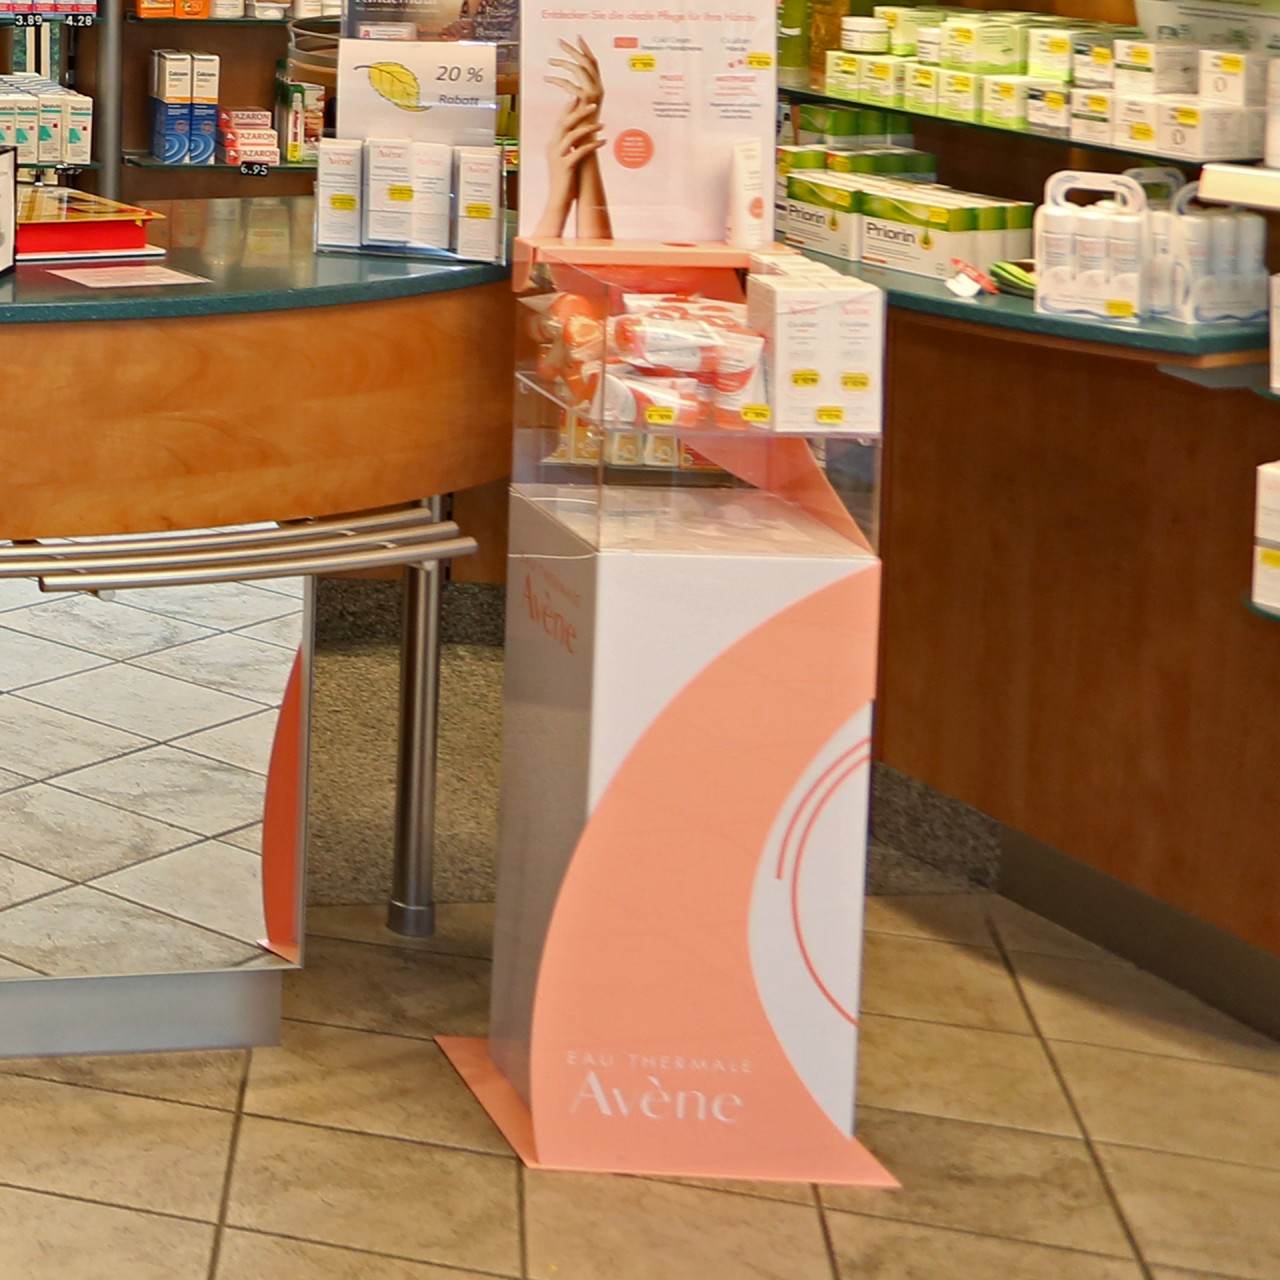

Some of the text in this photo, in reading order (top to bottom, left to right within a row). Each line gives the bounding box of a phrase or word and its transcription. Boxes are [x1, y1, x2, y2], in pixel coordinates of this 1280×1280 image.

[66, 16, 92, 26] 4.28
[436, 65, 484, 82] 20 %
[439, 95, 478, 106] Rabatt
[241, 165, 268, 175] 6.95
[866, 222, 916, 242] Priorin
[522, 577, 578, 654] Avène
[566, 1051, 752, 1073] EAU THERMALE
[572, 1071, 744, 1123] Avène
